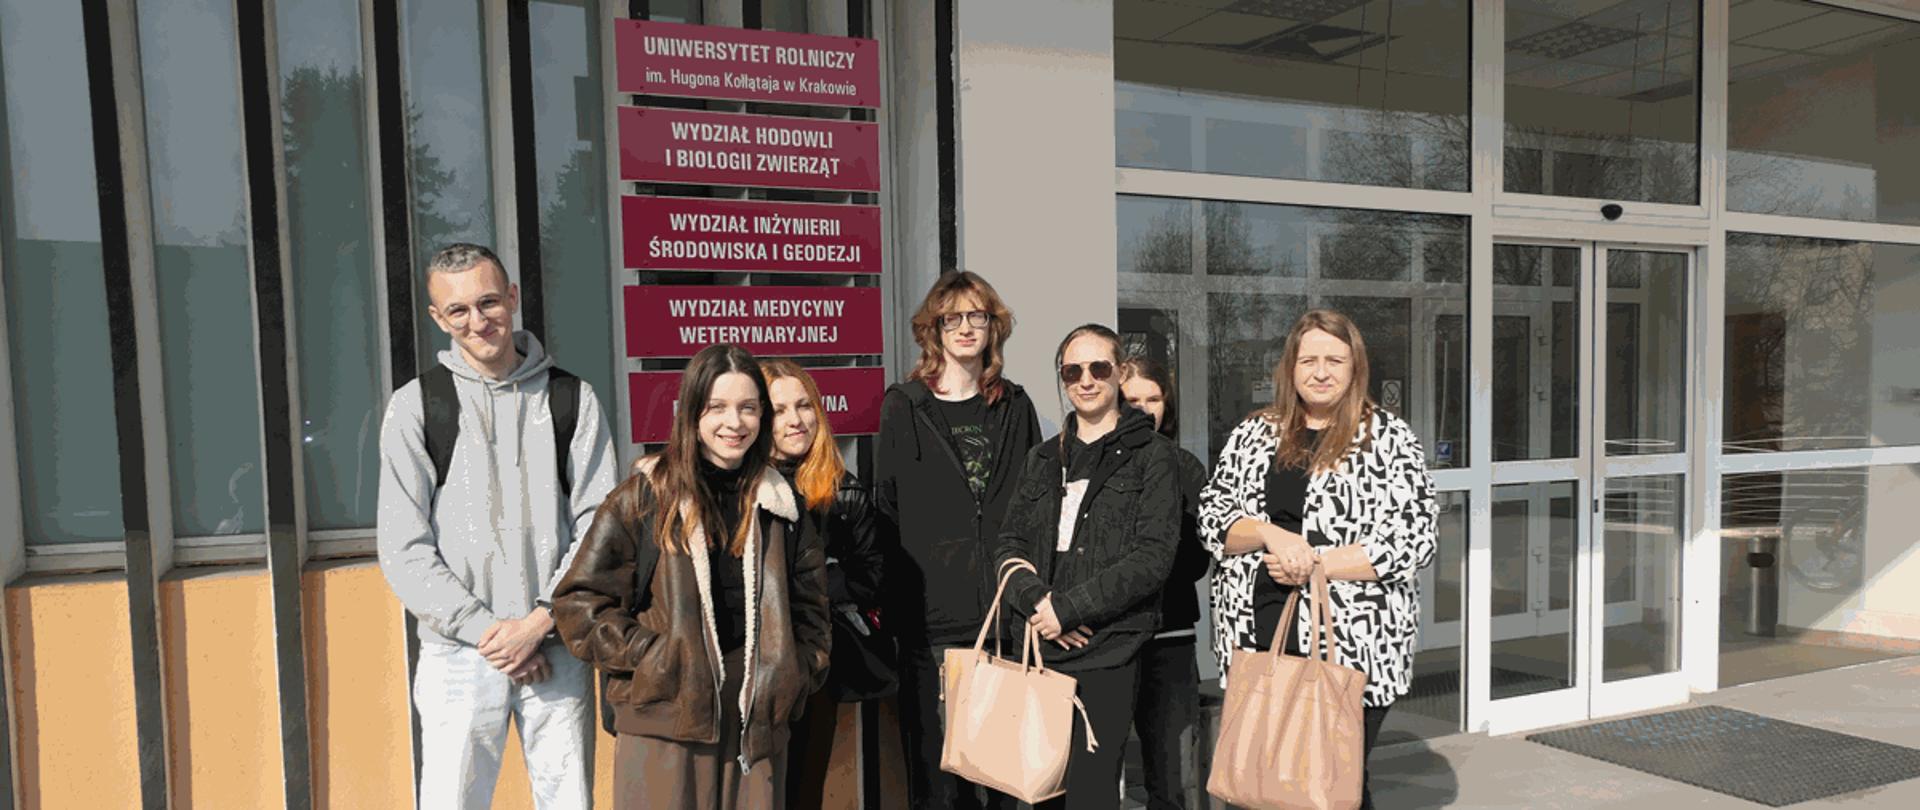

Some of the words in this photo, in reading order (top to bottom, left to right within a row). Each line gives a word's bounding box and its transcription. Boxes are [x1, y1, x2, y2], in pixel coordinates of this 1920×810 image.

[644, 37, 770, 63] UNIWERSYTET
[776, 47, 855, 69] ROLNICZY
[646, 67, 666, 83] im.
[671, 69, 720, 88] Hugona
[725, 72, 779, 93] Kołłątaja
[784, 80, 795, 91] w
[800, 78, 856, 95] Krakowie
[672, 122, 751, 143] WYDZIAŁ
[756, 127, 832, 148] HODOWLI
[665, 149, 672, 166] I
[677, 150, 751, 170] BIOLOGII
[757, 154, 840, 178] ZWIERZĄT
[670, 214, 748, 233] WYDZIAŁ
[754, 214, 840, 236] INŻYNIERII
[650, 236, 767, 259] ŚRODOWISKA
[772, 244, 778, 260] I
[784, 244, 860, 262] GEODEZJI
[669, 300, 748, 317] WYDZIAŁ
[754, 300, 844, 317] MEDYCYNY
[680, 326, 837, 343] WETERYNARYJNEJ
